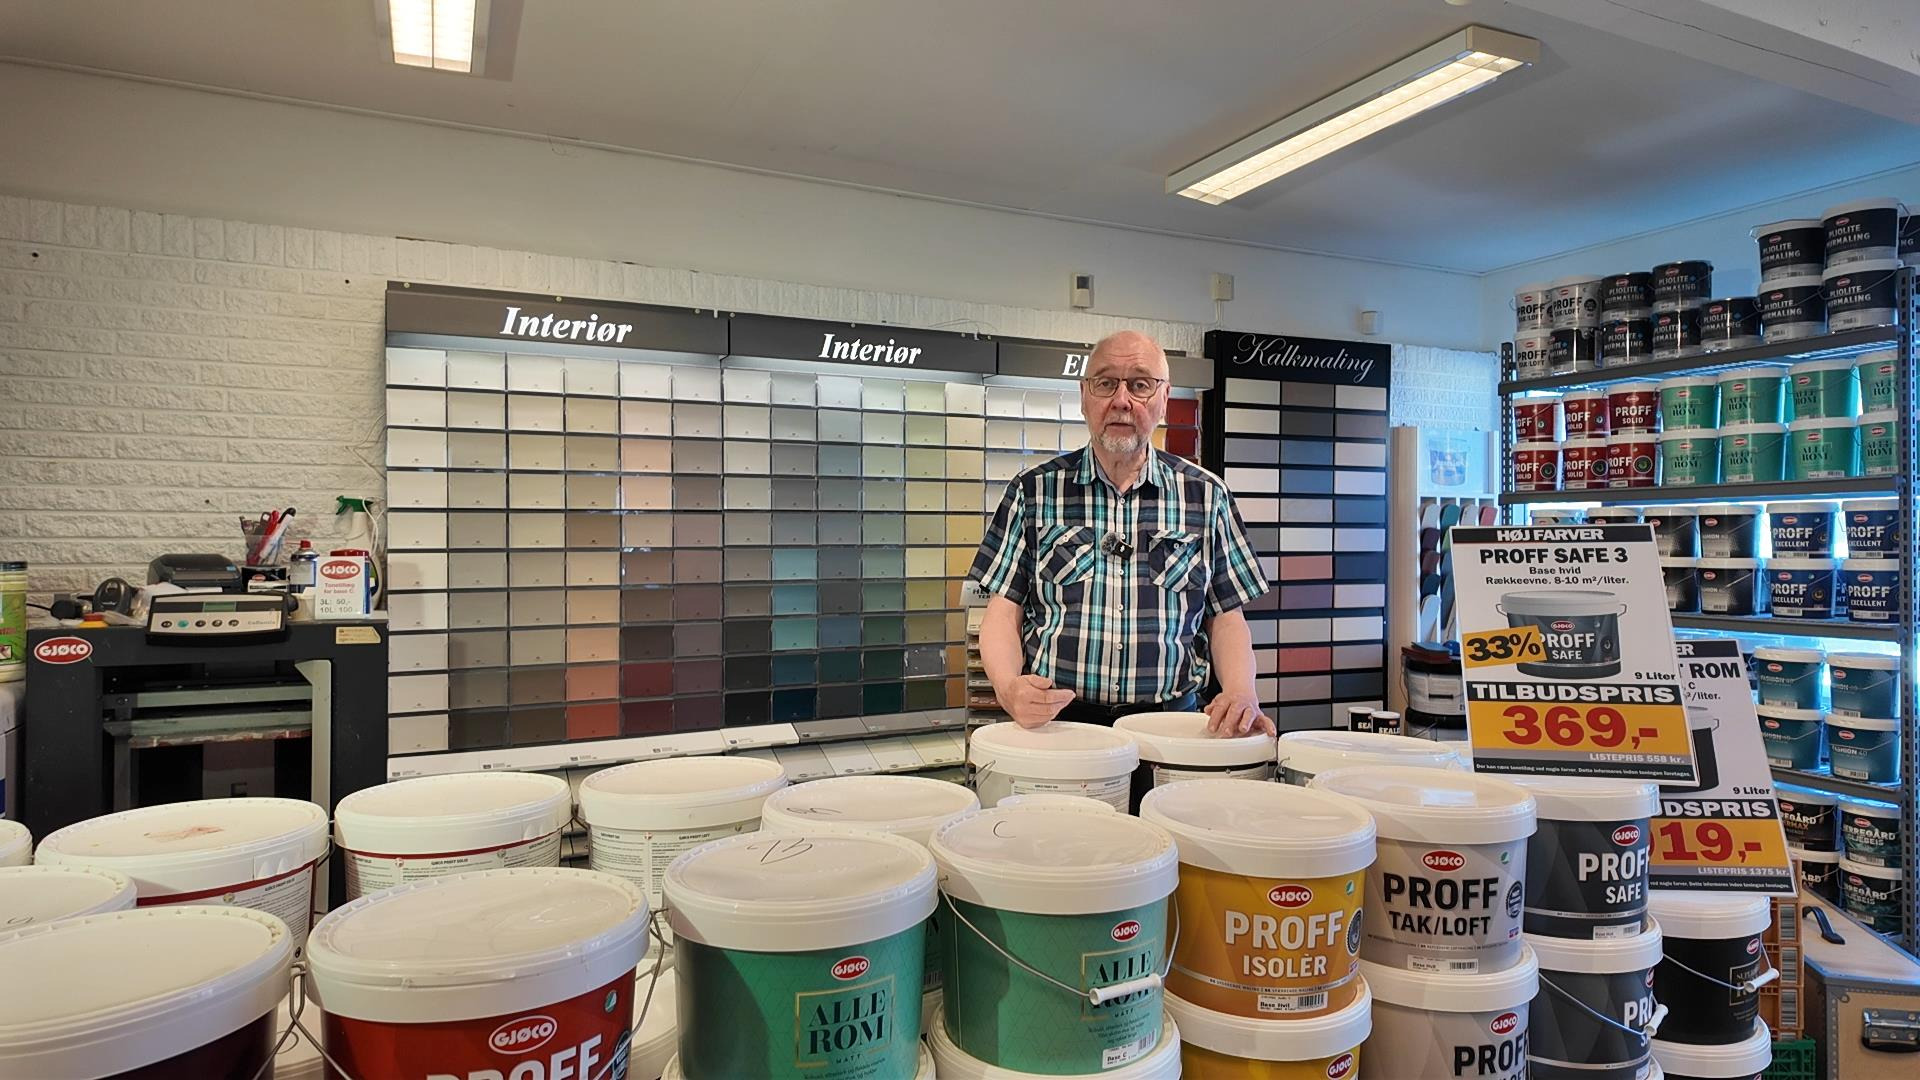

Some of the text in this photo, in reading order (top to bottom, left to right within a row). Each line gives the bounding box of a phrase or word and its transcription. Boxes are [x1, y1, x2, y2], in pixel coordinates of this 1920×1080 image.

[499, 306, 633, 343] Interiør
[818, 333, 922, 365] Interiør
[1232, 334, 1376, 383] Kalkmaling
[1875, 380, 1898, 388] ALL
[1566, 411, 1591, 422] ROFF
[1615, 405, 1652, 417] PROFF
[1517, 417, 1532, 427] OFF
[1608, 457, 1633, 467] ROFF
[1497, 529, 1604, 542] HØJ FARVER
[1773, 527, 1813, 539] PROFF
[1847, 525, 1885, 539] PROFF
[1480, 547, 1629, 564] PROFF SAFE 3
[322, 565, 359, 576] GJØCO
[1529, 566, 1582, 575] Base hvid
[1486, 576, 1552, 585] Rækkeevne.
[1554, 576, 1579, 585] 8-10
[1771, 583, 1808, 595] PROFF
[1848, 585, 1891, 598] PROFF
[38, 643, 89, 656] GJØCO
[1467, 632, 1541, 662] 33%
[1552, 650, 1583, 660] SAFE
[1634, 671, 1676, 681] 9 Liter
[1689, 663, 1740, 678] ROM
[1472, 683, 1675, 702] TILBUDSPRIS
[1685, 692, 1721, 701] ²/liter.
[1379, 726, 1400, 734] SEALE
[1502, 705, 1659, 750] 369,-
[1590, 752, 1685, 764] LISTEPRIS 558 kr.
[1733, 786, 1771, 795] 9 Liter
[1661, 801, 1771, 817] DSPRIS
[1780, 812, 1817, 825] REGÅRD
[1614, 830, 1639, 841] GJØCO
[1649, 821, 1762, 863] 19,-
[1424, 855, 1464, 866] GJØCO
[1698, 866, 1790, 876] LISTEPRIS 1375 kr.
[1270, 891, 1311, 902] GJØCO
[1383, 872, 1499, 910] PROFF
[1606, 882, 1641, 904] SAFE
[1845, 883, 1888, 900] RREGÅRD
[1225, 910, 1344, 950] PROFF
[1389, 911, 1491, 936] TAK/LOFT
[1113, 924, 1139, 937] GJØCO
[834, 960, 868, 976] GJØCO
[1093, 950, 1153, 985] ALLE
[808, 989, 886, 1028] ALLE
[1624, 996, 1654, 1028] PR
[1492, 1016, 1517, 1030] GJØCO
[494, 1022, 552, 1046] GJØCO
[808, 1015, 884, 1055] ROM
[836, 1054, 861, 1064] MATT
